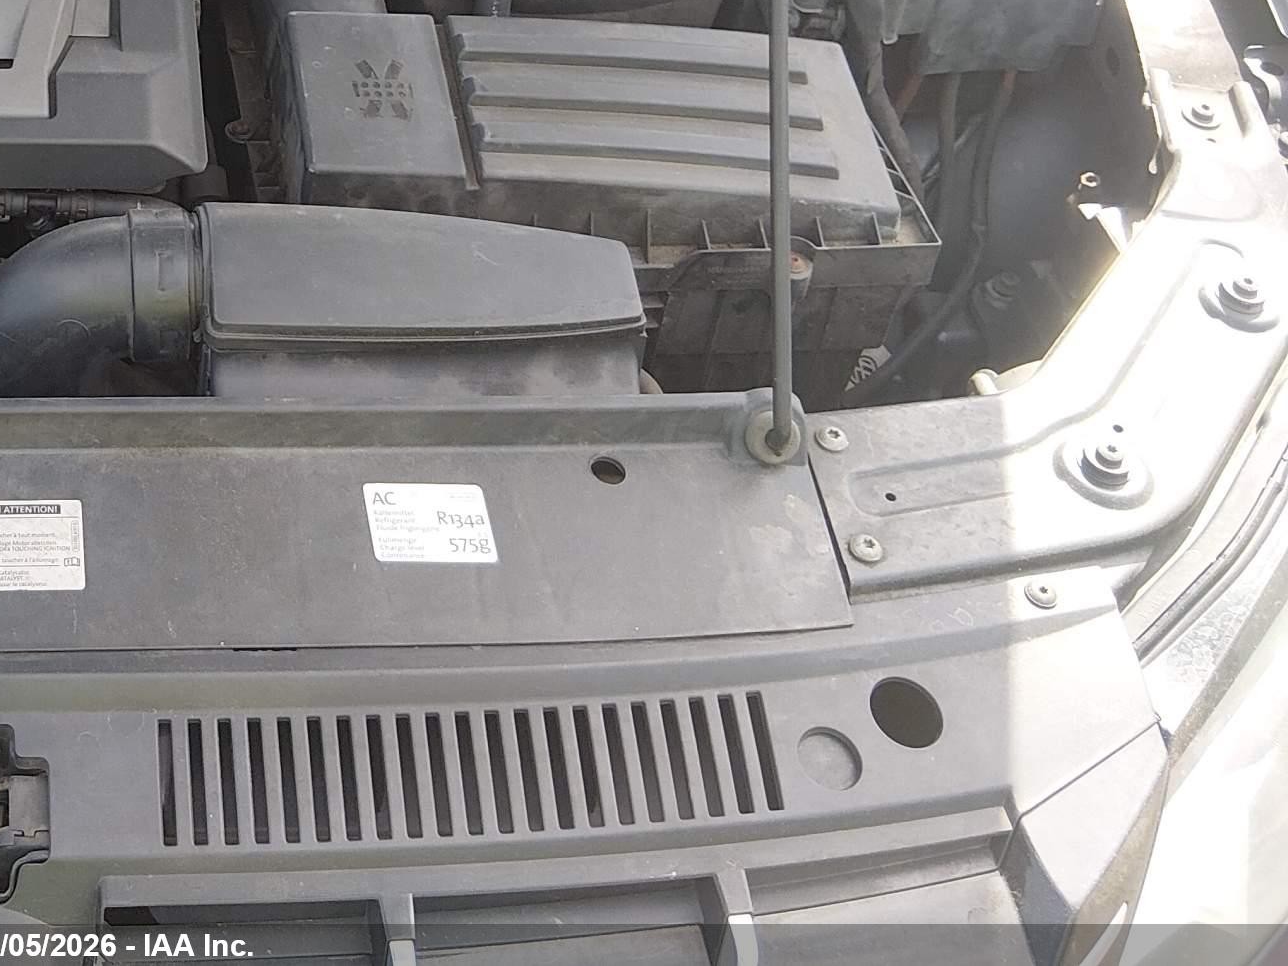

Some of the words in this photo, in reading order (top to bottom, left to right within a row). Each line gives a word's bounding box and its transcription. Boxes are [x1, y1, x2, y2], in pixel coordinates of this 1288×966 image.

[372, 491, 397, 505] AC
[3, 505, 58, 514] ATTENTION!
[436, 510, 485, 529] R134a
[449, 537, 492, 555] 575g
